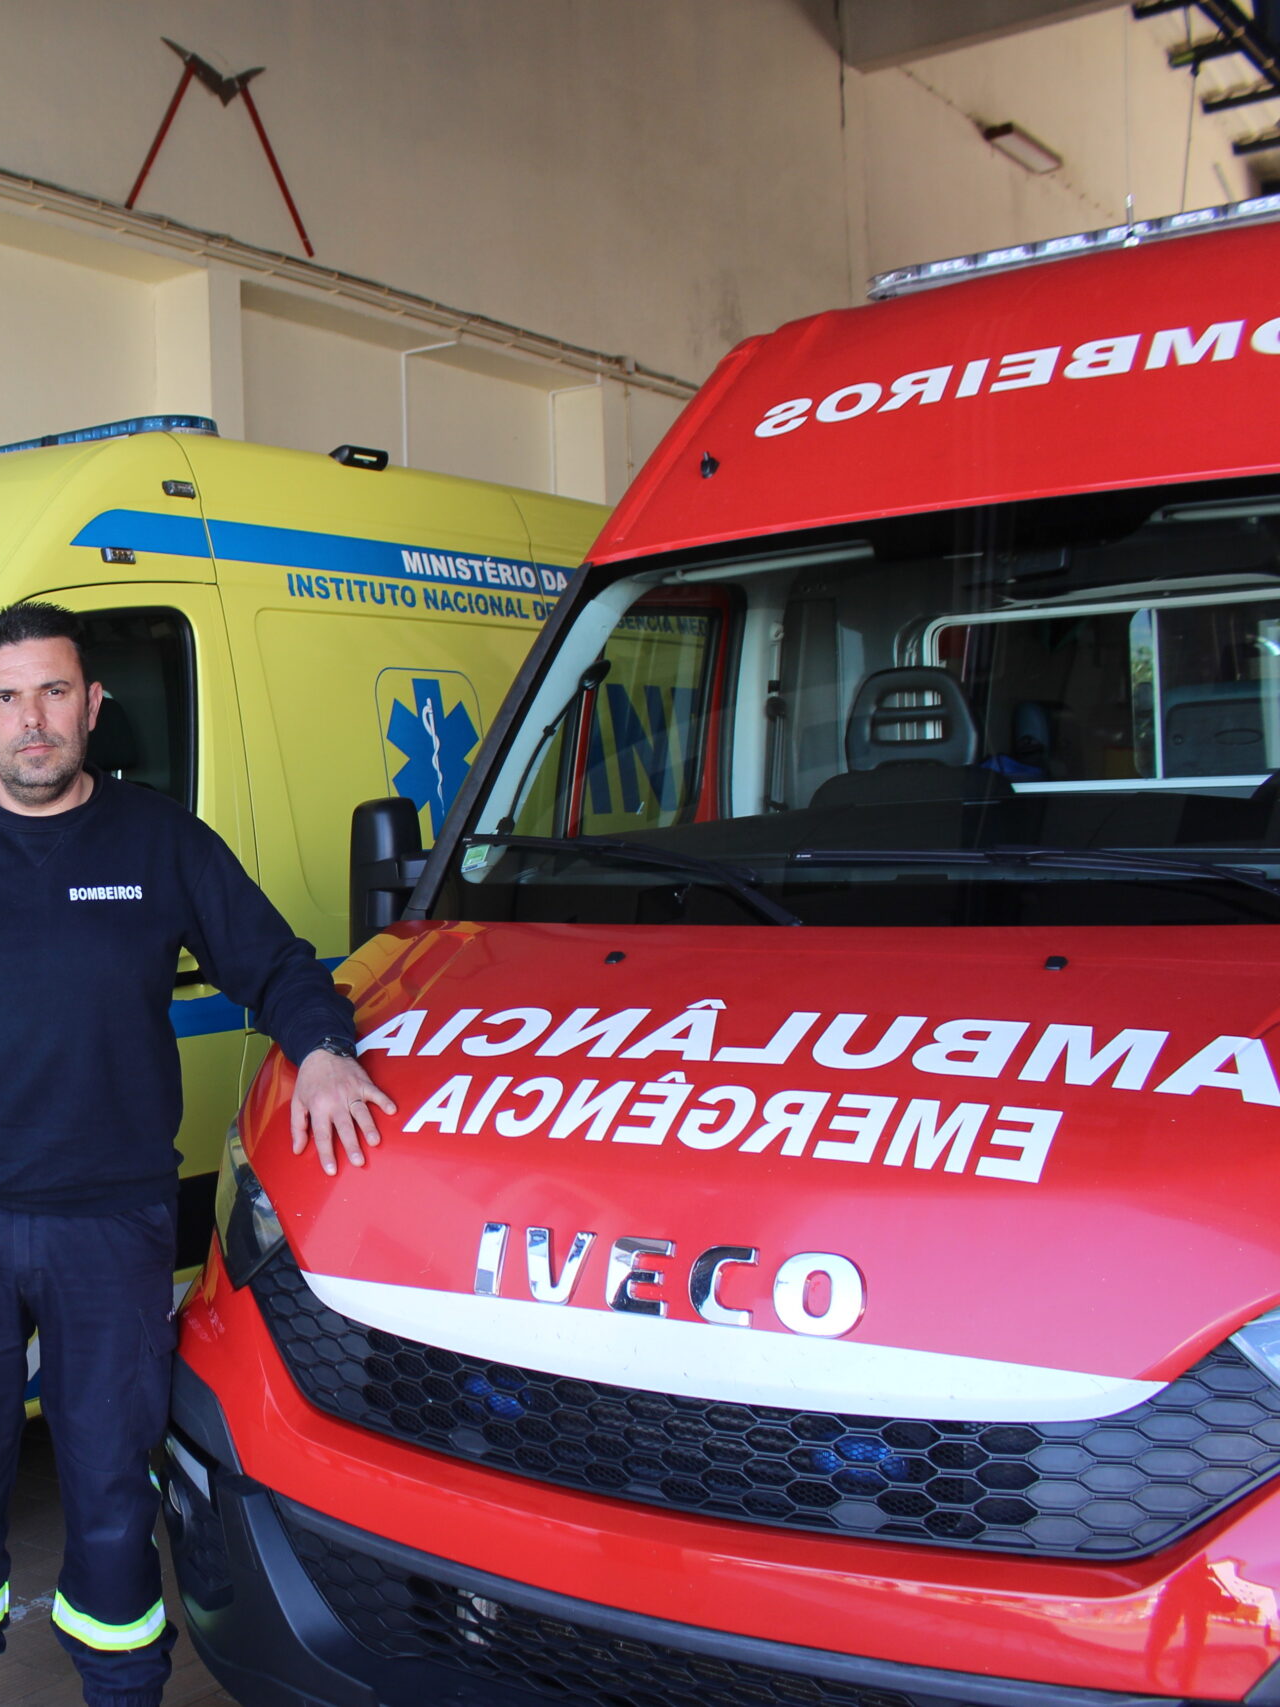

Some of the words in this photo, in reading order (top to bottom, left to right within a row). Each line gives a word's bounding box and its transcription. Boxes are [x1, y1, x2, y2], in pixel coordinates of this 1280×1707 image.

[401, 550, 536, 588] MINISTÉRIO
[539, 571, 568, 592] DA
[287, 573, 417, 608] INSTITUTO
[423, 587, 530, 621] NACIONAL
[69, 885, 143, 901] BOMBEIROS
[473, 1220, 868, 1339] IVECO
